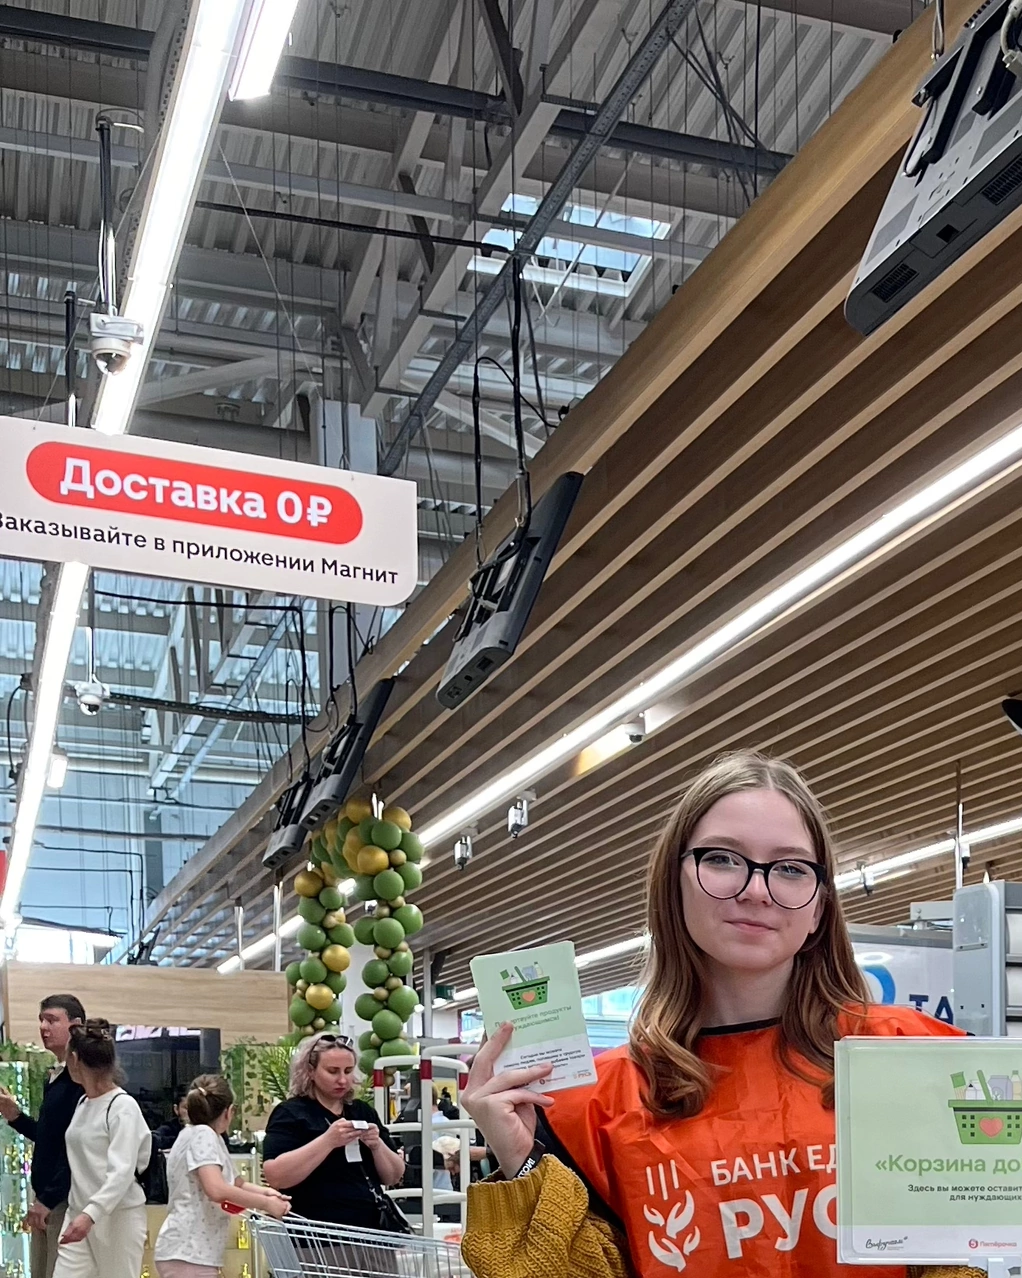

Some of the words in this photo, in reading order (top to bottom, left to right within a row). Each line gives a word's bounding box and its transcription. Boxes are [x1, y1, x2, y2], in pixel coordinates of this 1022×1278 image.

[60, 457, 267, 520] Доставка
[154, 537, 166, 552] в
[172, 540, 316, 574] приложении
[322, 557, 399, 585] Магнит
[711, 1148, 801, 1186] БАНК
[875, 1154, 986, 1176] «Корзина
[907, 1184, 935, 1193] Здесь
[949, 1193, 966, 1202] для
